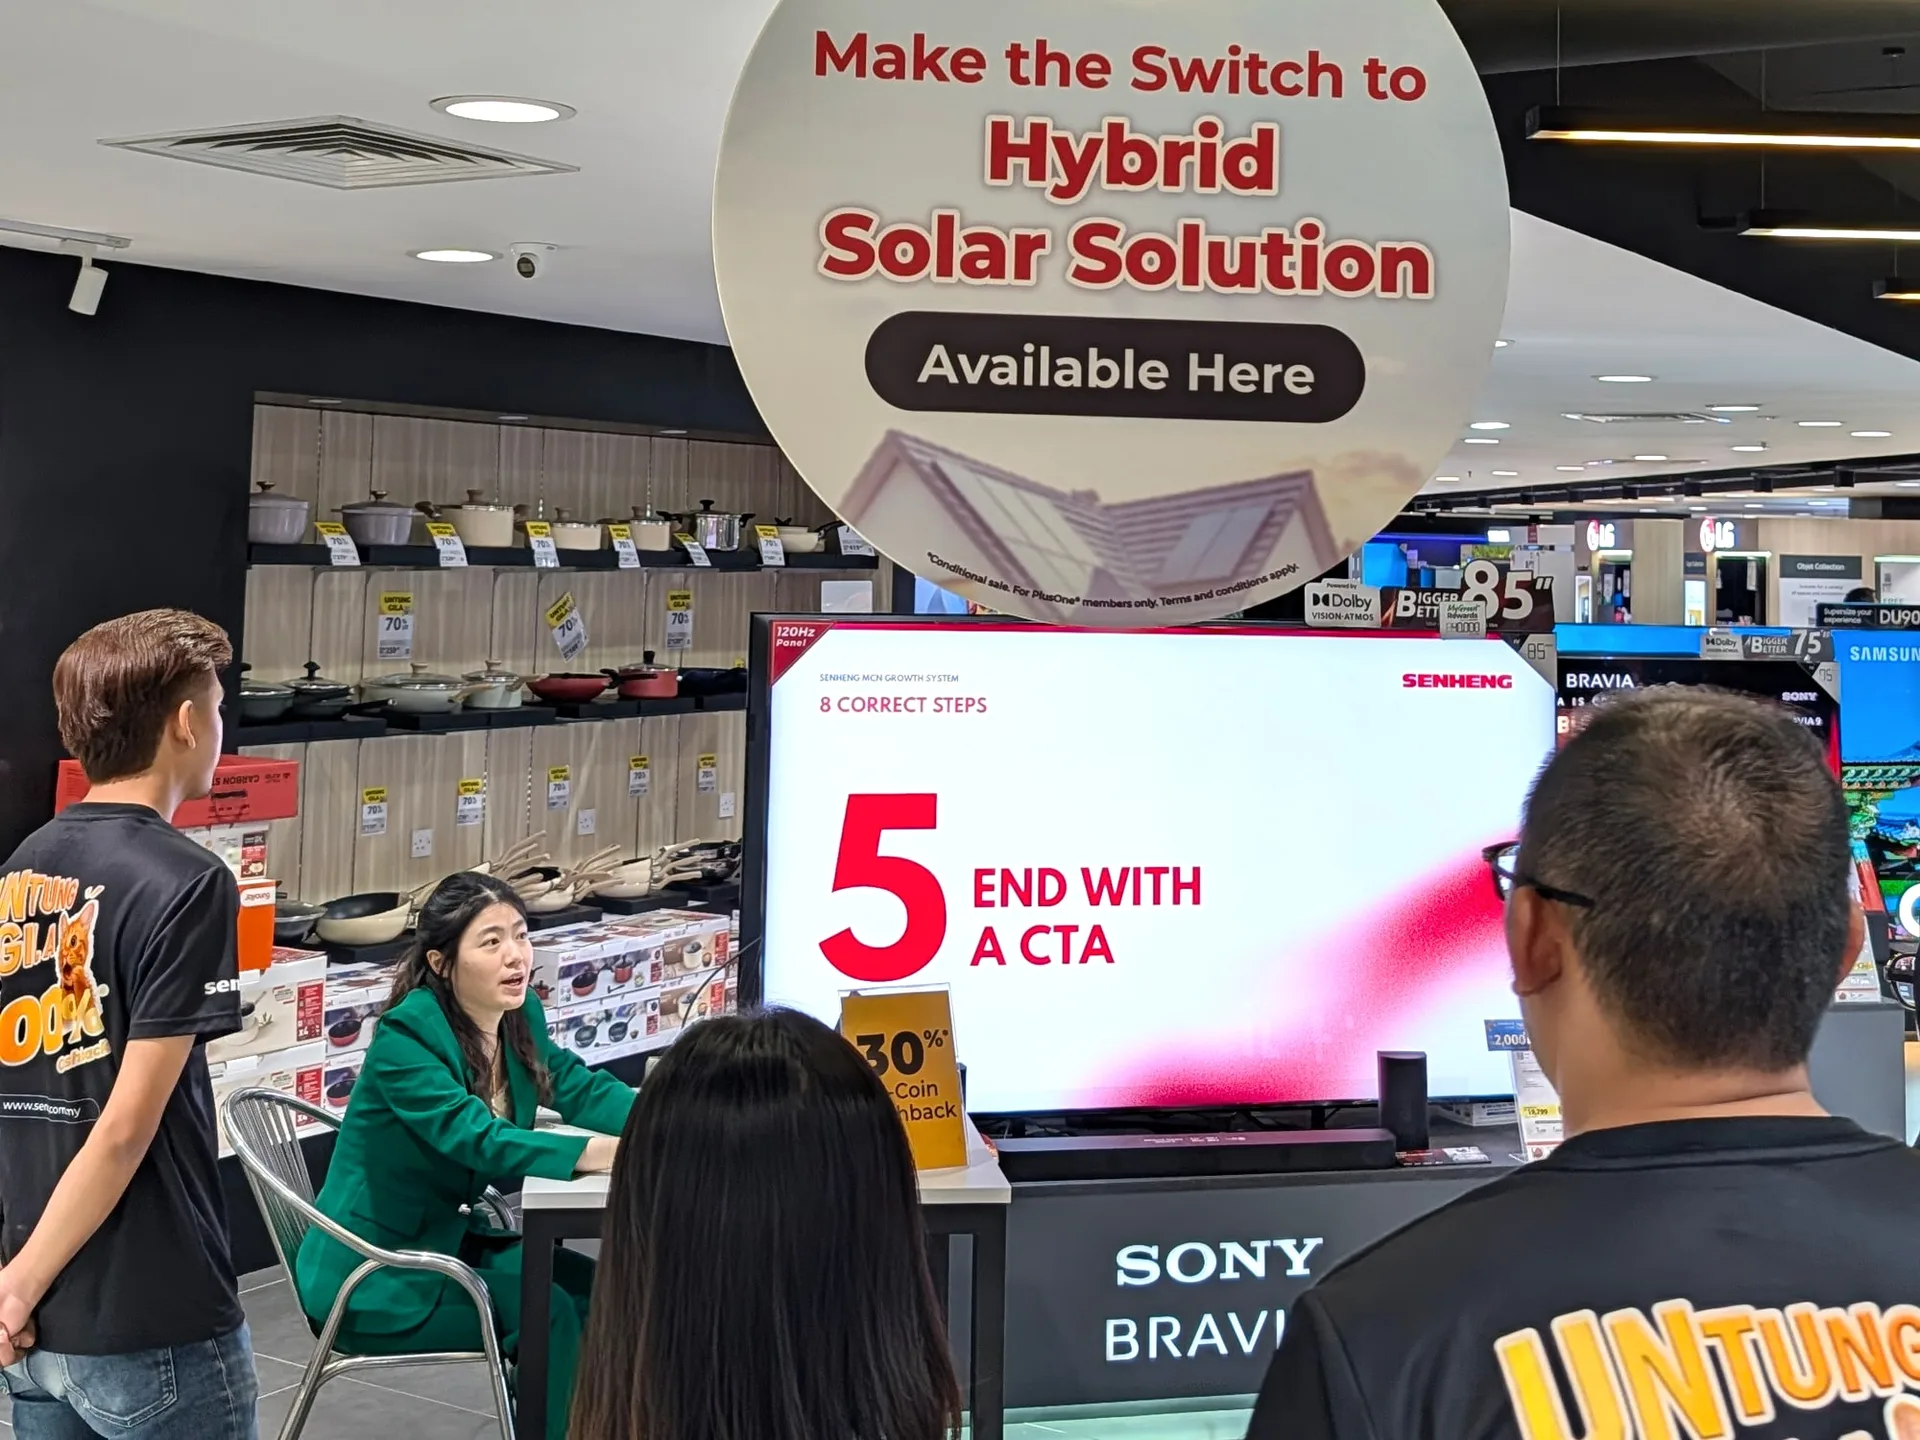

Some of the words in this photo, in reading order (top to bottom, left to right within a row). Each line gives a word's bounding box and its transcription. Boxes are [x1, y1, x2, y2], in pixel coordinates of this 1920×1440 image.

[814, 29, 987, 85] Make
[1005, 38, 1112, 90] the
[1131, 44, 1344, 99] Switch
[1363, 56, 1427, 102] to
[988, 117, 1278, 200] Hybrid
[822, 211, 1047, 281] Solar
[1071, 220, 1431, 296] Solution
[917, 342, 1169, 392] Available
[1188, 352, 1316, 395] Here
[1715, 521, 1735, 548] LG
[988, 578, 1011, 593] sale.
[1012, 585, 1030, 597] For
[1082, 598, 1132, 608] members
[1134, 598, 1159, 609] only.
[1160, 594, 1192, 607] Terms
[1194, 589, 1214, 602] and
[1215, 575, 1268, 598] conditions
[1269, 563, 1300, 581] apply.
[1332, 594, 1372, 612] Dolby
[1824, 608, 1856, 616] Supersize
[1857, 609, 1872, 617] your
[776, 627, 816, 639] 120Hz
[776, 639, 807, 648] Panel
[1716, 638, 1737, 647] Dolby
[820, 674, 860, 682] SENHENG
[862, 674, 883, 682] MCN
[884, 674, 924, 682] GROWTH
[1402, 673, 1513, 689] SENHENG
[1566, 673, 1635, 688] BRAVIA
[820, 696, 831, 713] 8
[837, 696, 927, 713] CORRECT
[933, 697, 987, 713] STEPS
[1781, 691, 1819, 701] SONY
[818, 792, 948, 983] 5
[973, 867, 1067, 908] END
[1080, 866, 1201, 907] WITH
[970, 925, 1007, 967] A
[1020, 924, 1115, 966] CTA
[888, 1080, 939, 1099] -Coin
[1115, 1237, 1324, 1287] SONY
[1105, 1308, 1286, 1363] BRAVI
